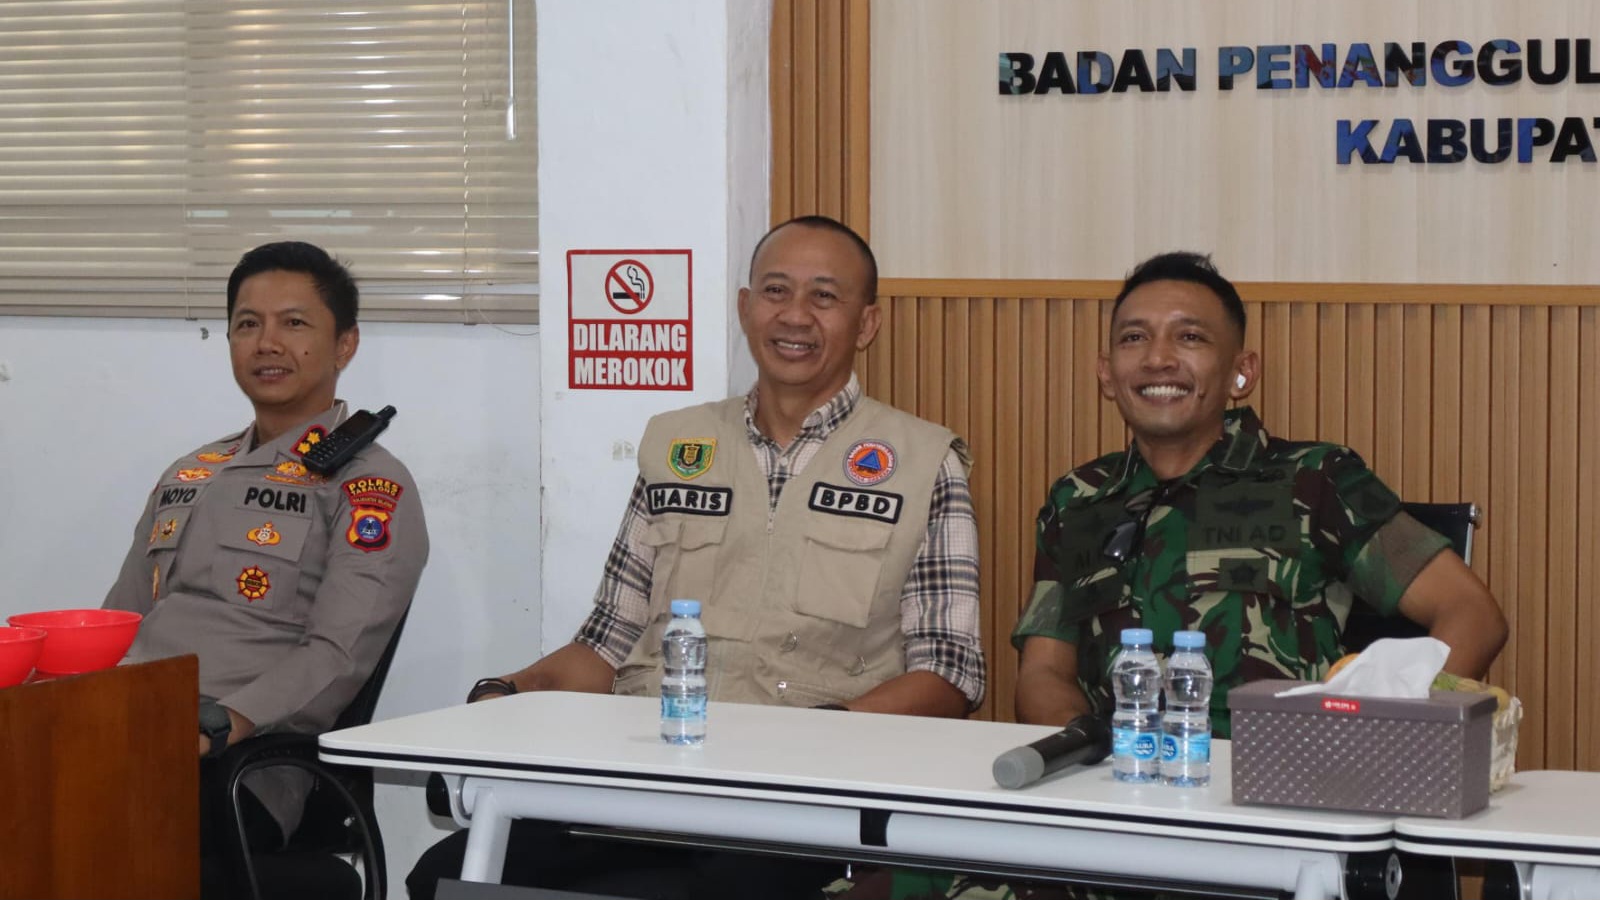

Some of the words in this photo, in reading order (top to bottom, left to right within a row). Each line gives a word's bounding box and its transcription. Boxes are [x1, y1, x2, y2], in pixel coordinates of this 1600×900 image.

[998, 47, 1197, 95] BADAN
[1217, 38, 1600, 90] PENANGGUL
[1336, 116, 1600, 165] KABUPA
[573, 323, 687, 352] DILARANG
[574, 356, 687, 386] MEROKOK
[348, 478, 399, 493] POLRES
[653, 488, 722, 510] HARIS
[244, 486, 306, 513] POLRI
[819, 489, 891, 515] BPBD
[1202, 524, 1241, 544] TNI
[1249, 524, 1287, 543] AD
